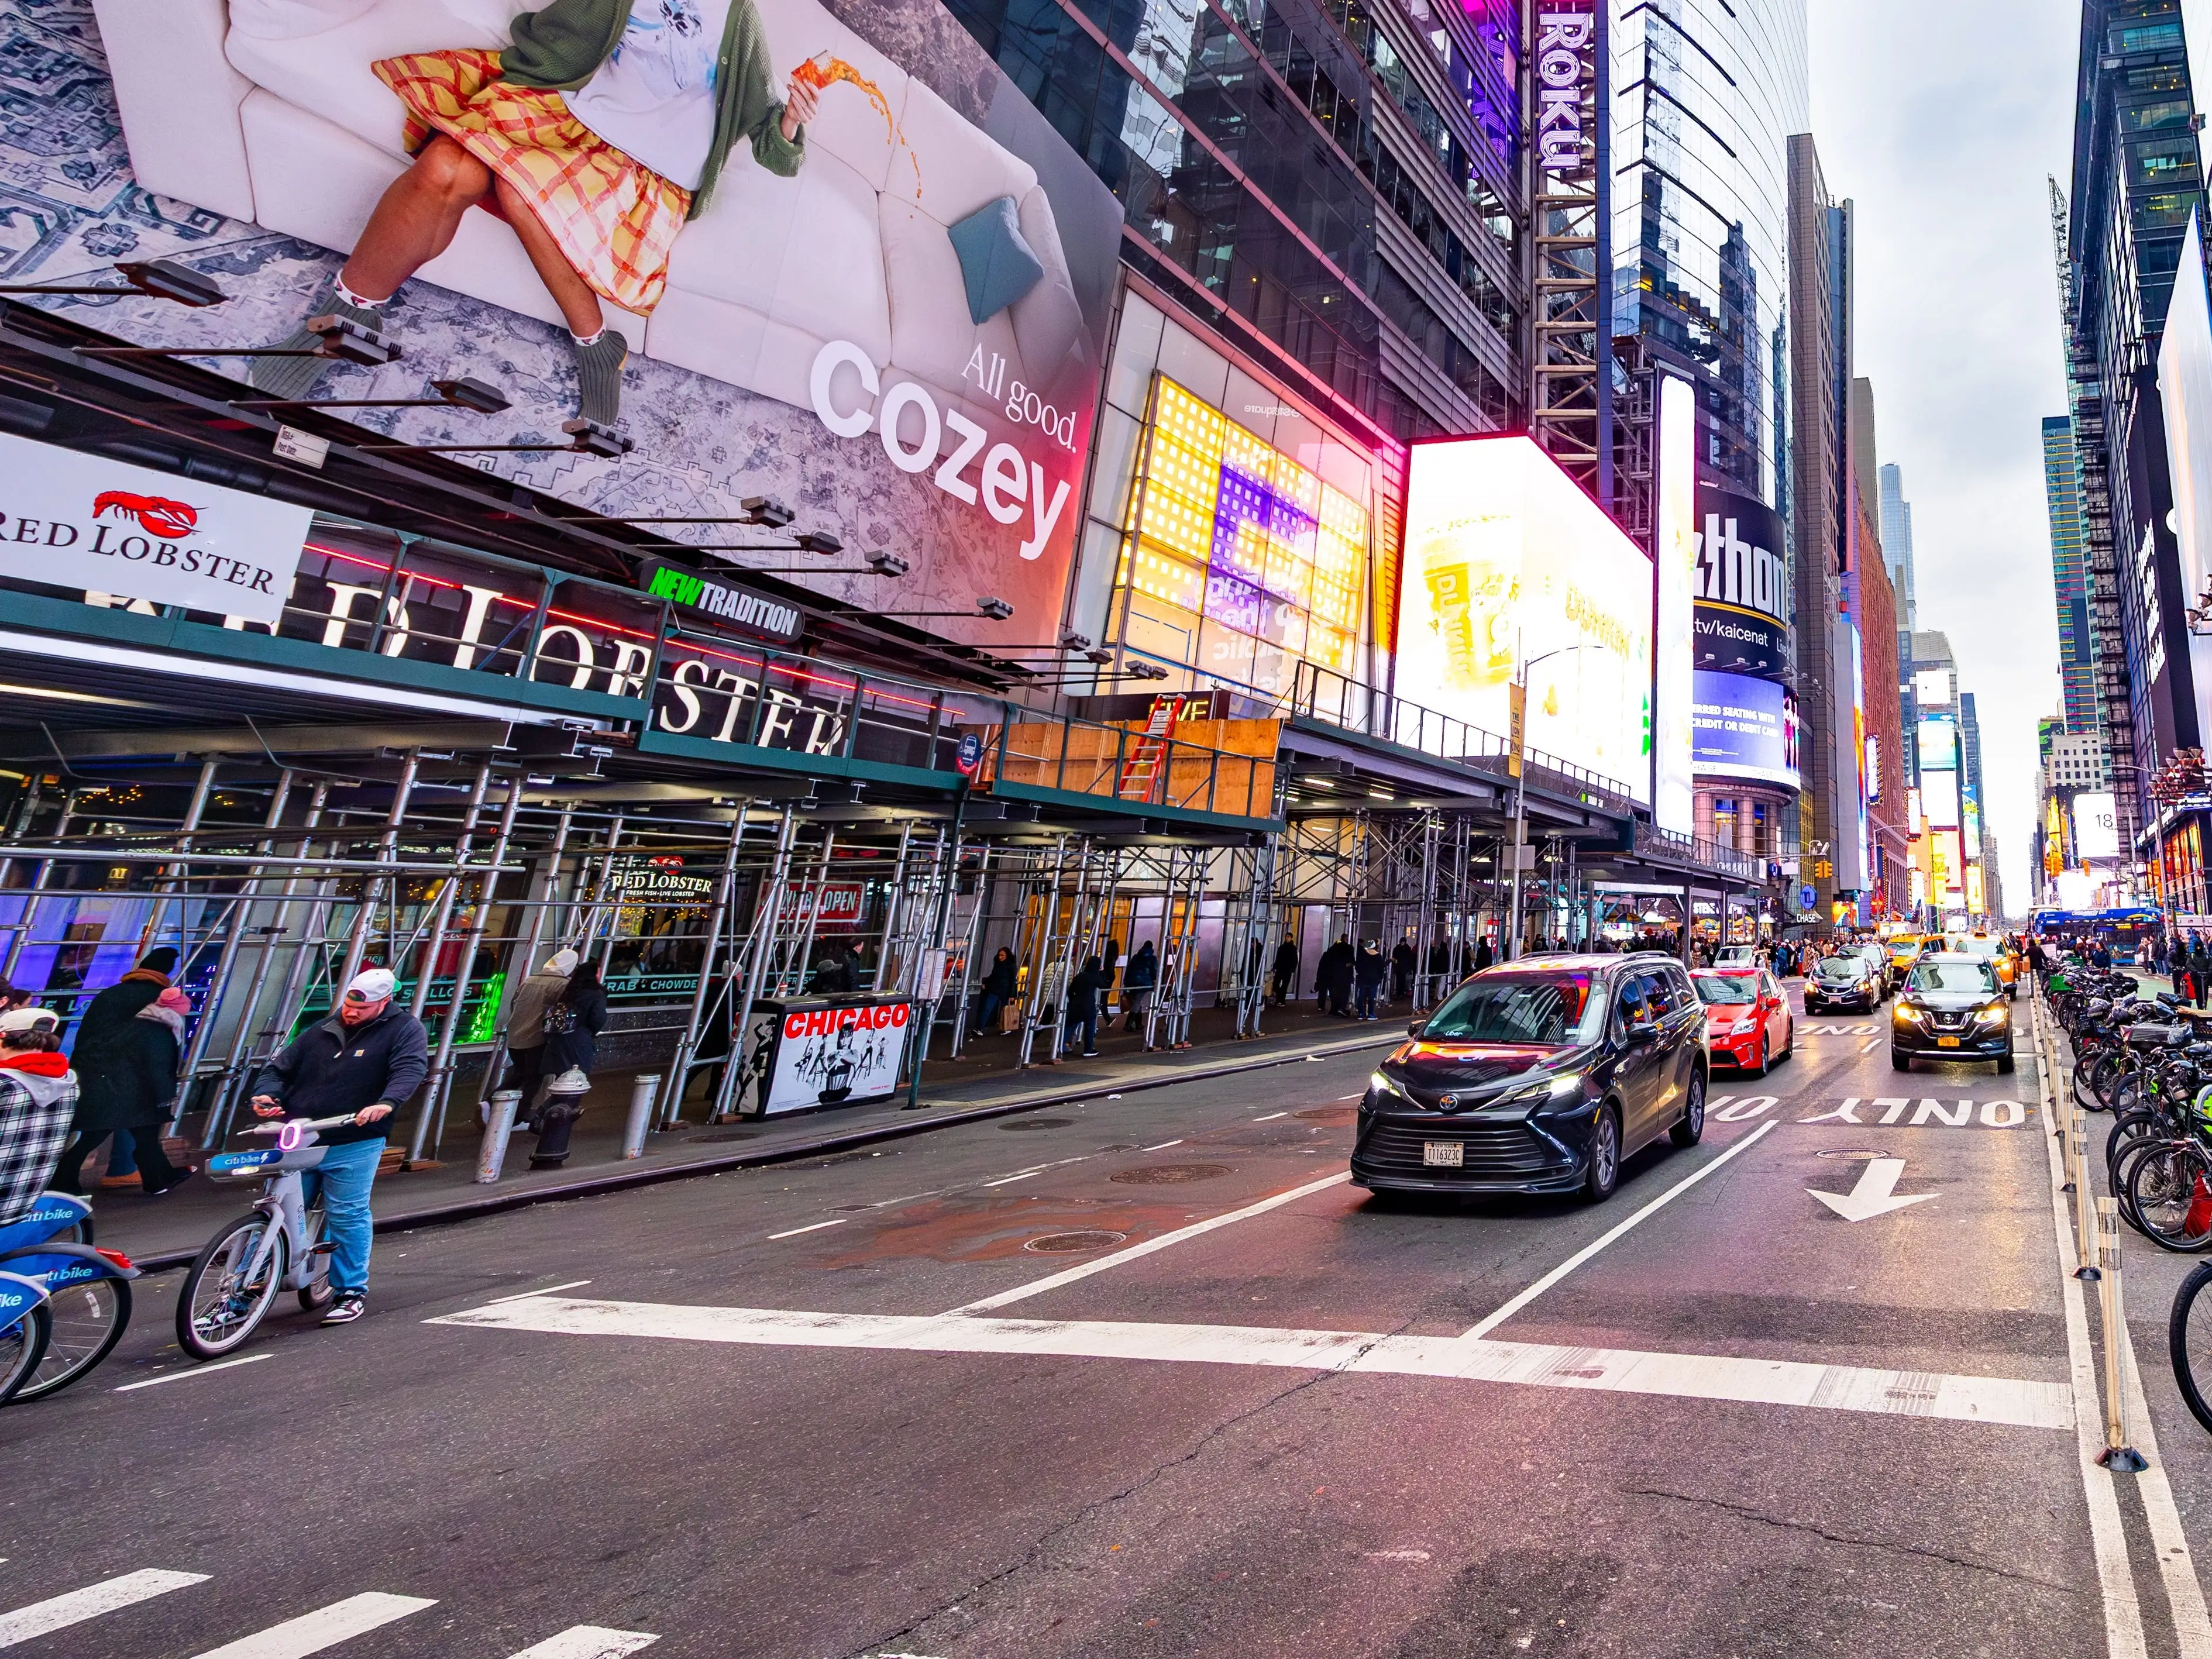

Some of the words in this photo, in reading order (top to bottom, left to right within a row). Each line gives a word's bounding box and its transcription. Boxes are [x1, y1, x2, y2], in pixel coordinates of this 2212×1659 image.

[961, 342, 1006, 400] All
[1004, 380, 1077, 453] good.
[810, 340, 1071, 561] cozey
[0, 511, 78, 547] ED
[88, 525, 272, 594] LOBSTER
[1723, 707, 1757, 721] SEATING
[1758, 711, 1776, 724] WITH
[1724, 721, 1739, 731] OR
[1739, 722, 1762, 735] DEBIT
[2094, 814, 2113, 828] 18
[648, 873, 712, 893] LOBSTER
[824, 890, 857, 911] OPEN
[1797, 913, 1816, 923] CHASE
[604, 980, 636, 992] RAB
[651, 979, 697, 990] CHOWDE
[785, 1003, 910, 1040] CHICAGO
[1795, 1025, 1882, 1035] ONL
[1797, 1097, 2025, 1127] ONLY
[225, 1156, 239, 1165] citi
[240, 1155, 260, 1164] bike
[1428, 1148, 1459, 1161] T116323C
[44, 1209, 73, 1220] bike
[60, 1267, 93, 1279] bike
